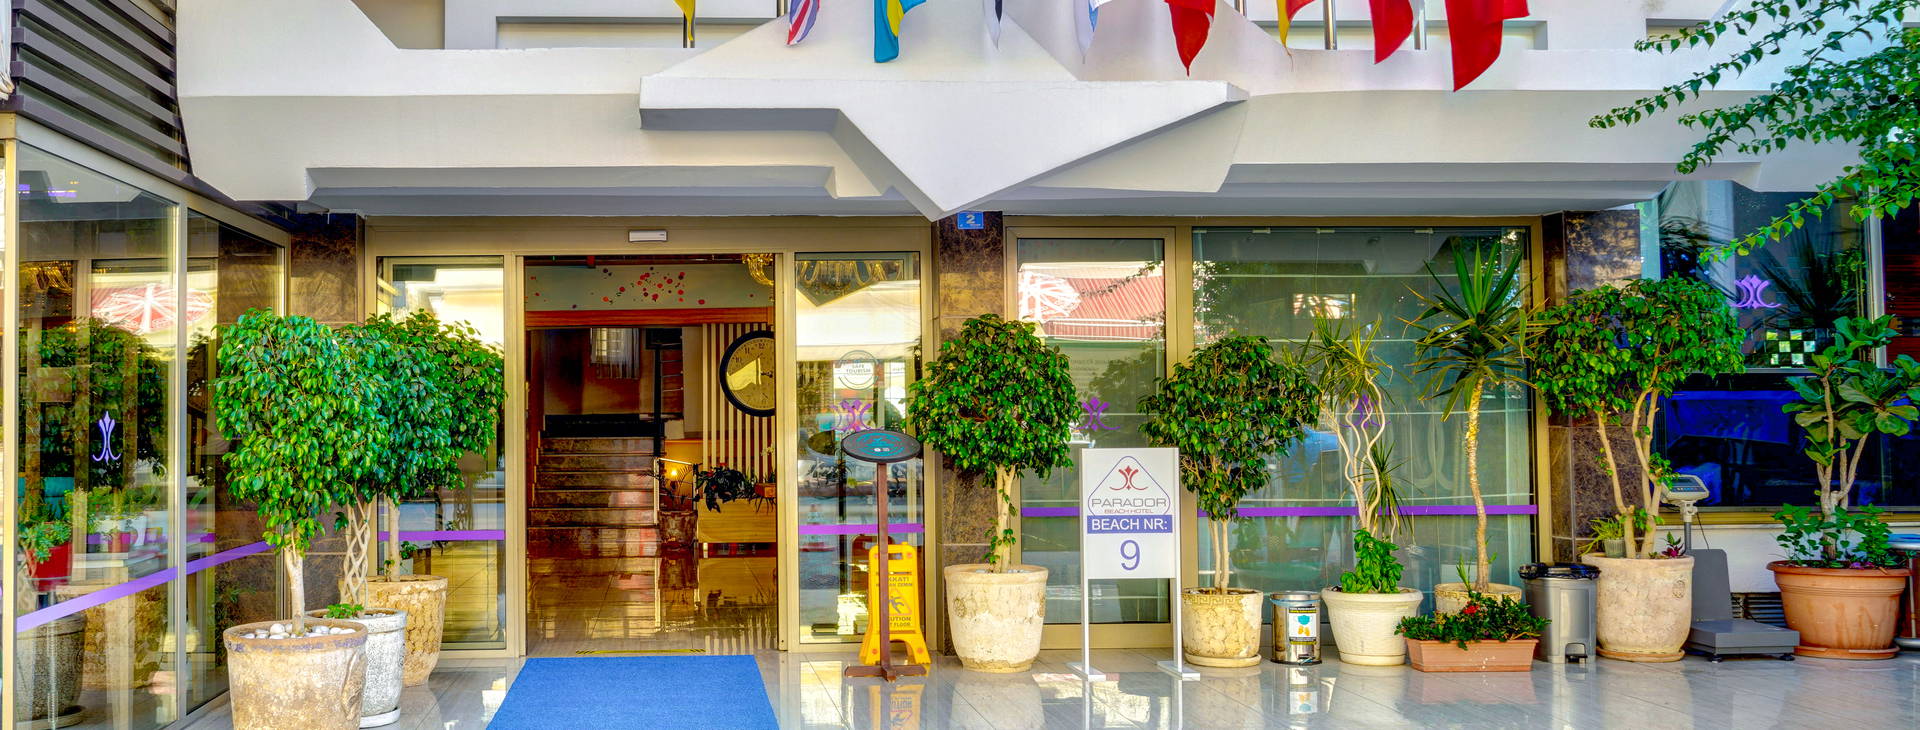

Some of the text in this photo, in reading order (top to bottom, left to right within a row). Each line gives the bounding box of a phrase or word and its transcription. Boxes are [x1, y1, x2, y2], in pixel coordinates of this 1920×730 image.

[966, 214, 976, 224] 2
[1091, 498, 1167, 508] PARADOR
[1091, 518, 1168, 531] BEACH NR:
[1120, 539, 1141, 571] 9
